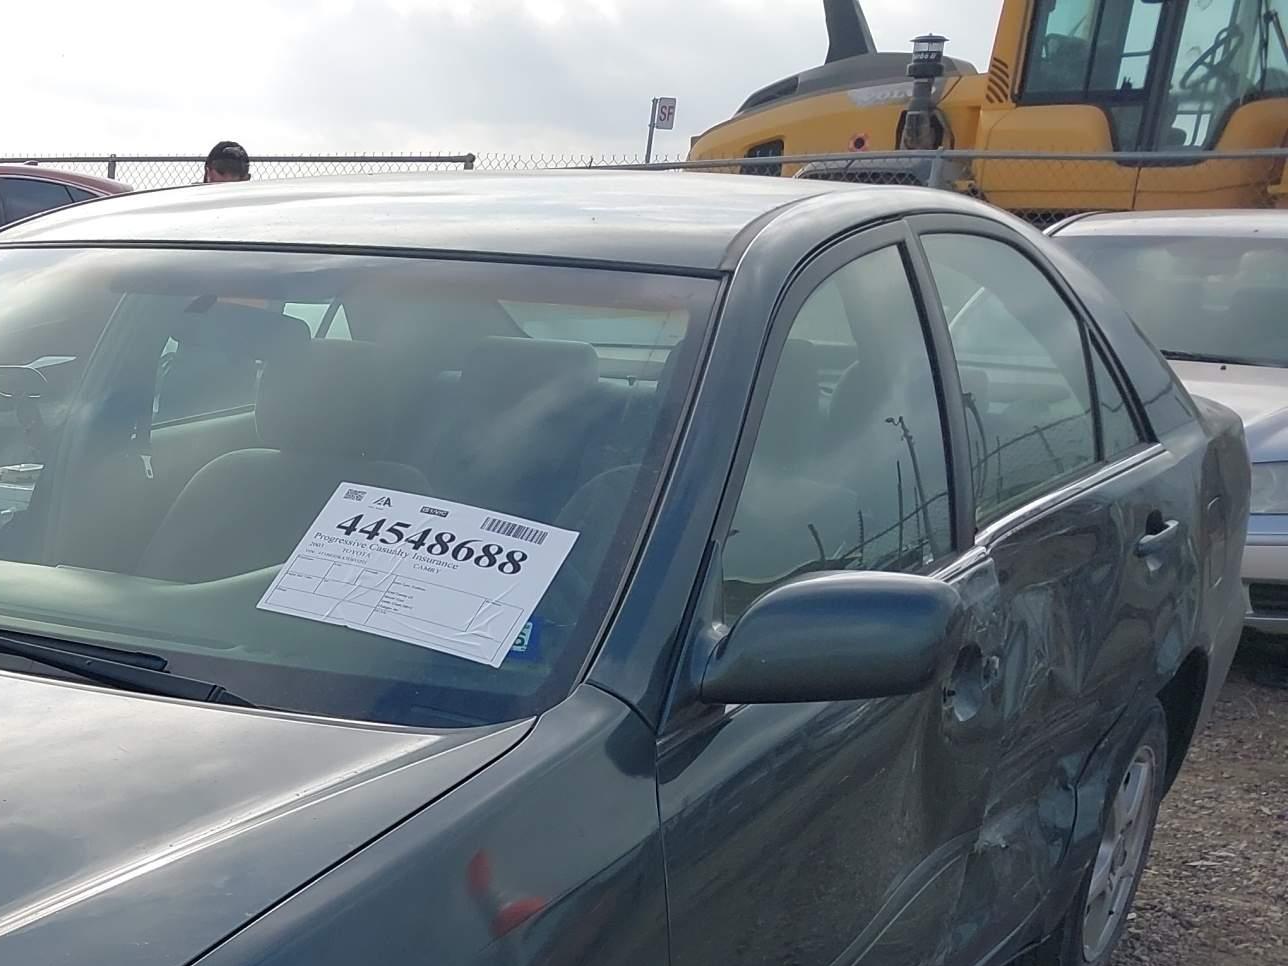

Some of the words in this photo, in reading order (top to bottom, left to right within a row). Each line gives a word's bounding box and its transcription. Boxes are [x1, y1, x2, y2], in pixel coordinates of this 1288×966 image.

[659, 105, 674, 122] SF
[314, 531, 368, 549] Progressive
[369, 542, 409, 560] Casualty
[412, 552, 460, 571] Insurance
[336, 513, 529, 575] 44548688
[413, 563, 442, 575] CAMRY
